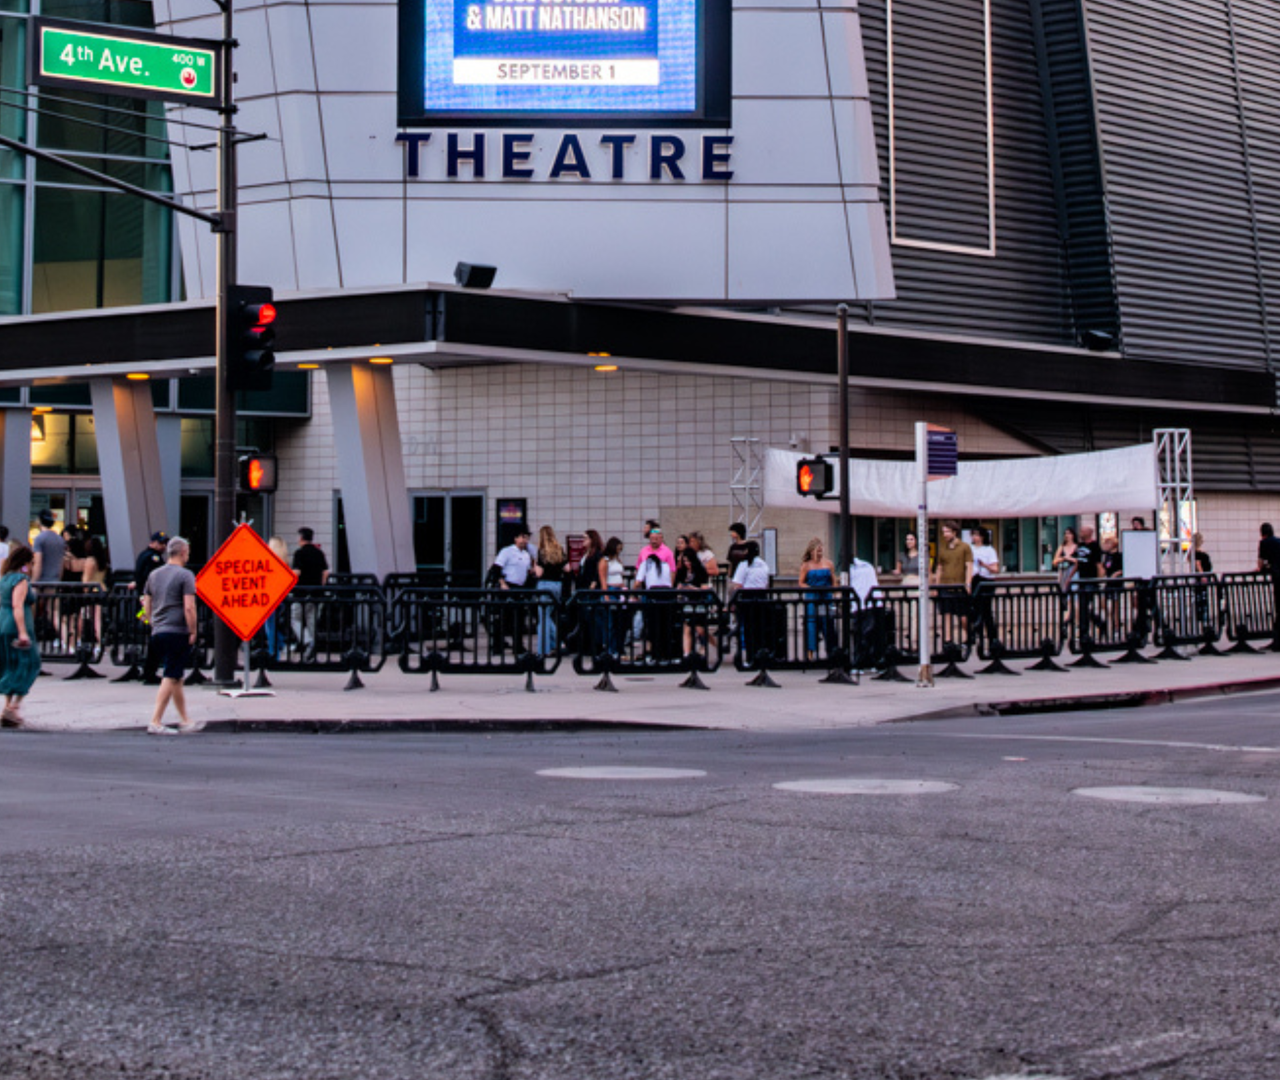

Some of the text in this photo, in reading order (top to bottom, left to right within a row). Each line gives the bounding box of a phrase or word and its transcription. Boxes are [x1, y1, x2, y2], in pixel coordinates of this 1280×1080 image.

[466, 6, 646, 30] & MATT NATHANSON
[59, 43, 150, 76] 4th Ave.
[172, 53, 193, 66] 400
[497, 63, 616, 80] SEPTEMBER 1
[395, 132, 735, 181] THEATRE
[215, 559, 274, 575] SPECIAL
[221, 576, 267, 592] EVENT
[221, 593, 270, 608] AHEAD
